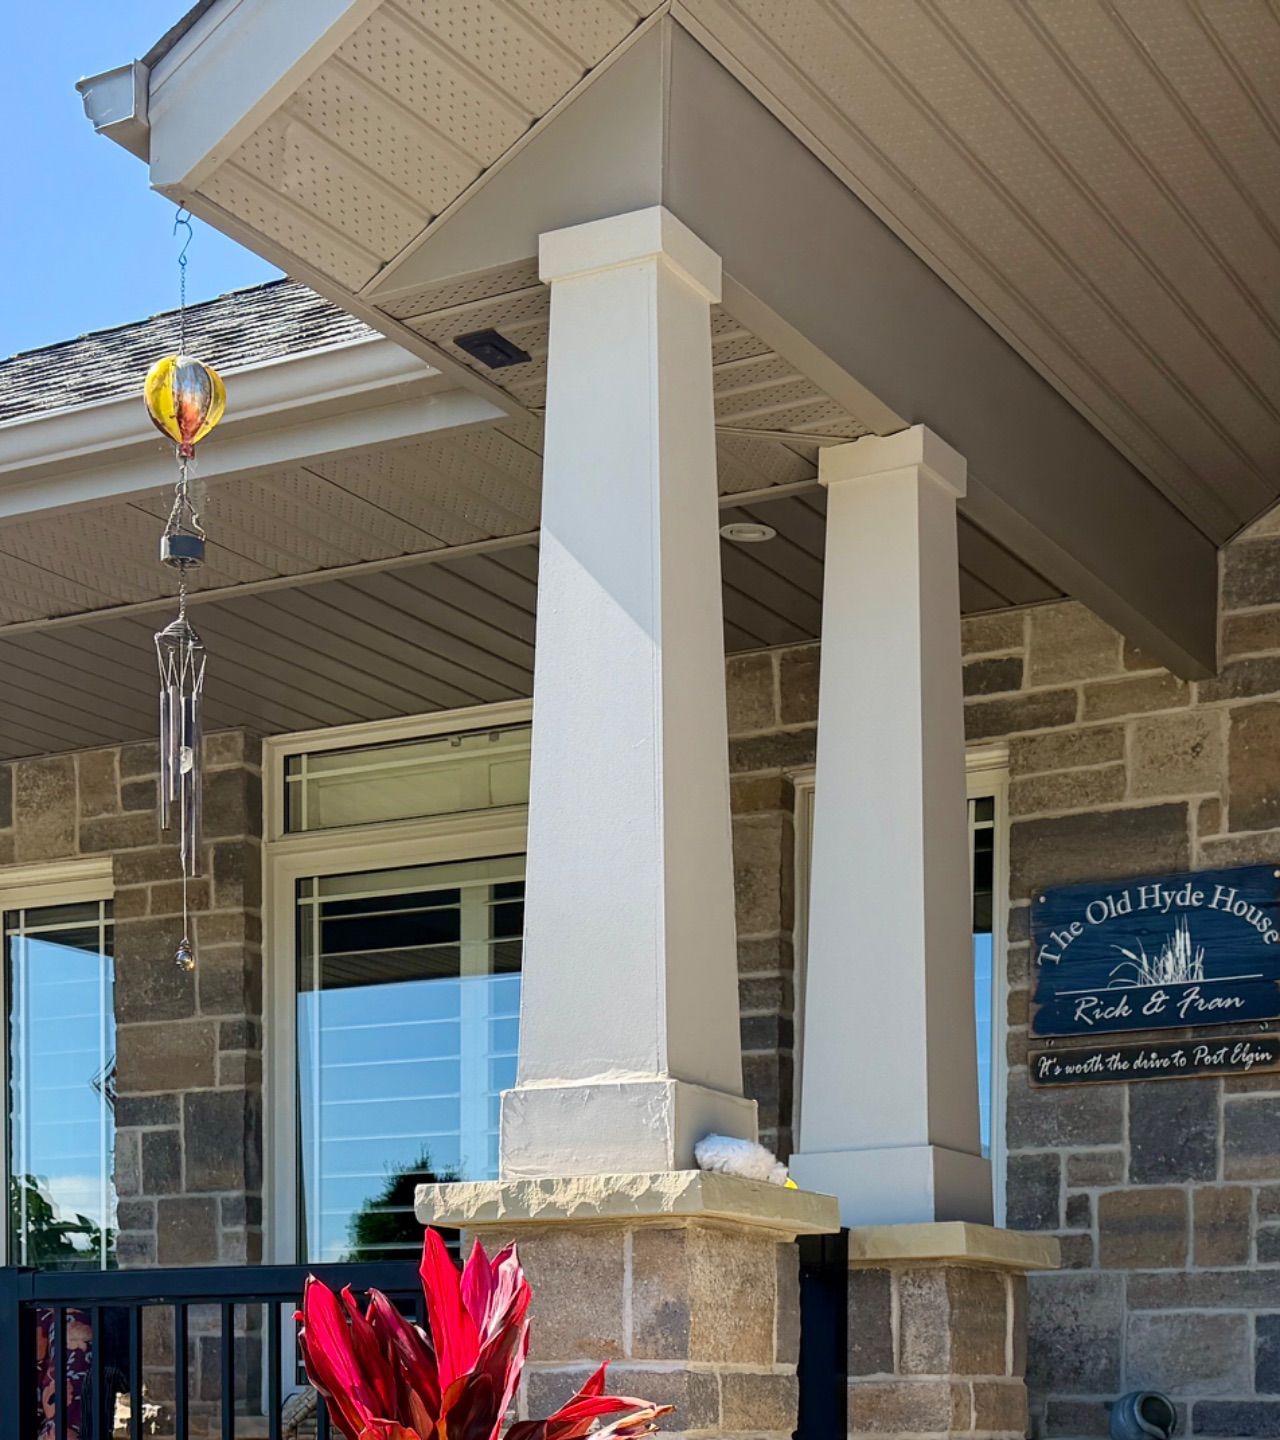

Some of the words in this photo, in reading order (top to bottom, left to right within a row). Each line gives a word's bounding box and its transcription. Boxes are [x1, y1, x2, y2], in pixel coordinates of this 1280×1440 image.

[1037, 919, 1084, 968] The
[1086, 890, 1132, 925] Old
[1137, 882, 1204, 914] Hyde
[1208, 884, 1279, 945] House
[1073, 994, 1132, 1026] Rick
[1142, 990, 1170, 1015] &
[1177, 986, 1245, 1019] Fran
[1038, 1056, 1061, 1078] It's
[1065, 1054, 1104, 1075] worth
[1105, 1051, 1129, 1071] the
[1133, 1050, 1170, 1070] drive
[1171, 1050, 1187, 1068] to
[1193, 1045, 1228, 1066] Port
[1230, 1042, 1272, 1071] Elgin
